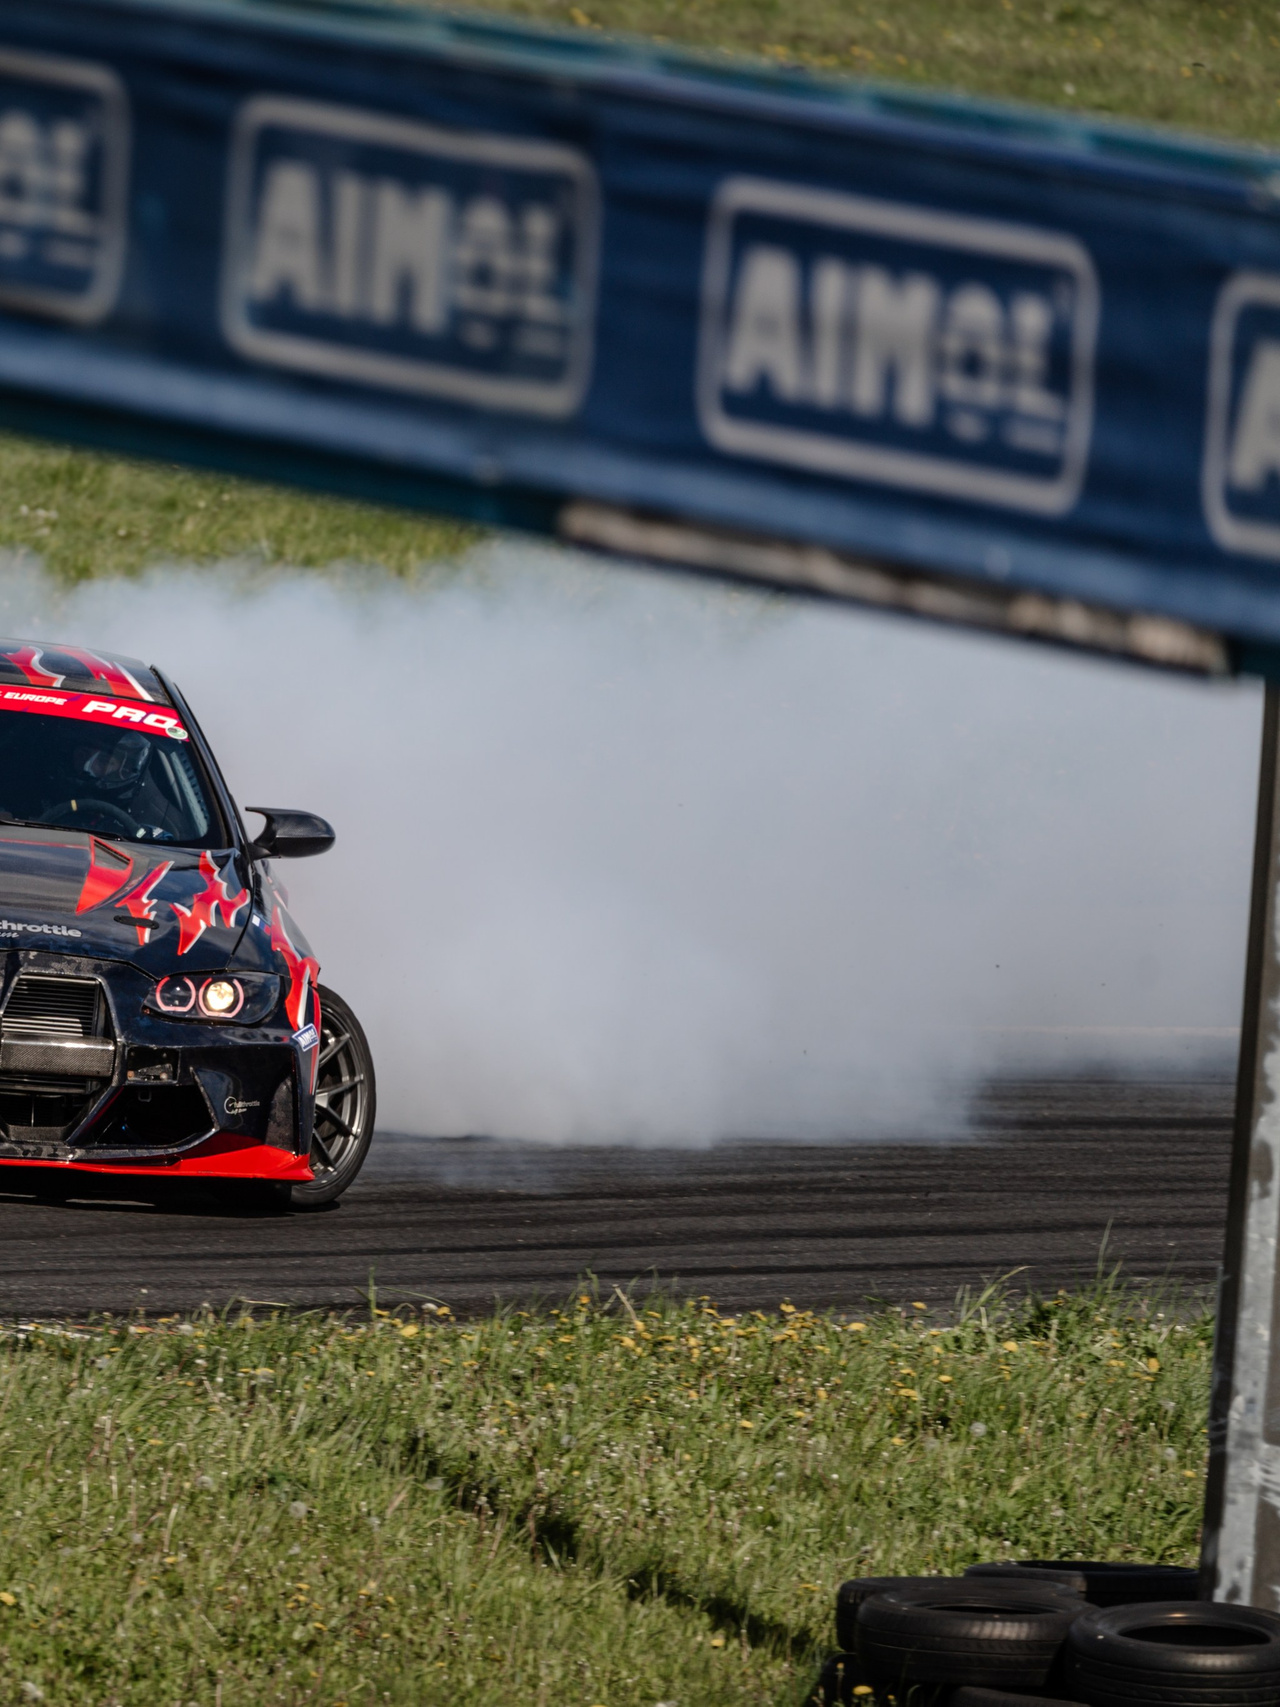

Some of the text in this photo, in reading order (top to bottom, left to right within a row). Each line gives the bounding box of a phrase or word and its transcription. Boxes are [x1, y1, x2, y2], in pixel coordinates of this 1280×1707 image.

[249, 160, 570, 350] AIMOL
[723, 244, 1066, 446] AIMOL
[4, 691, 68, 706] EUROPE
[82, 700, 178, 729] PRO
